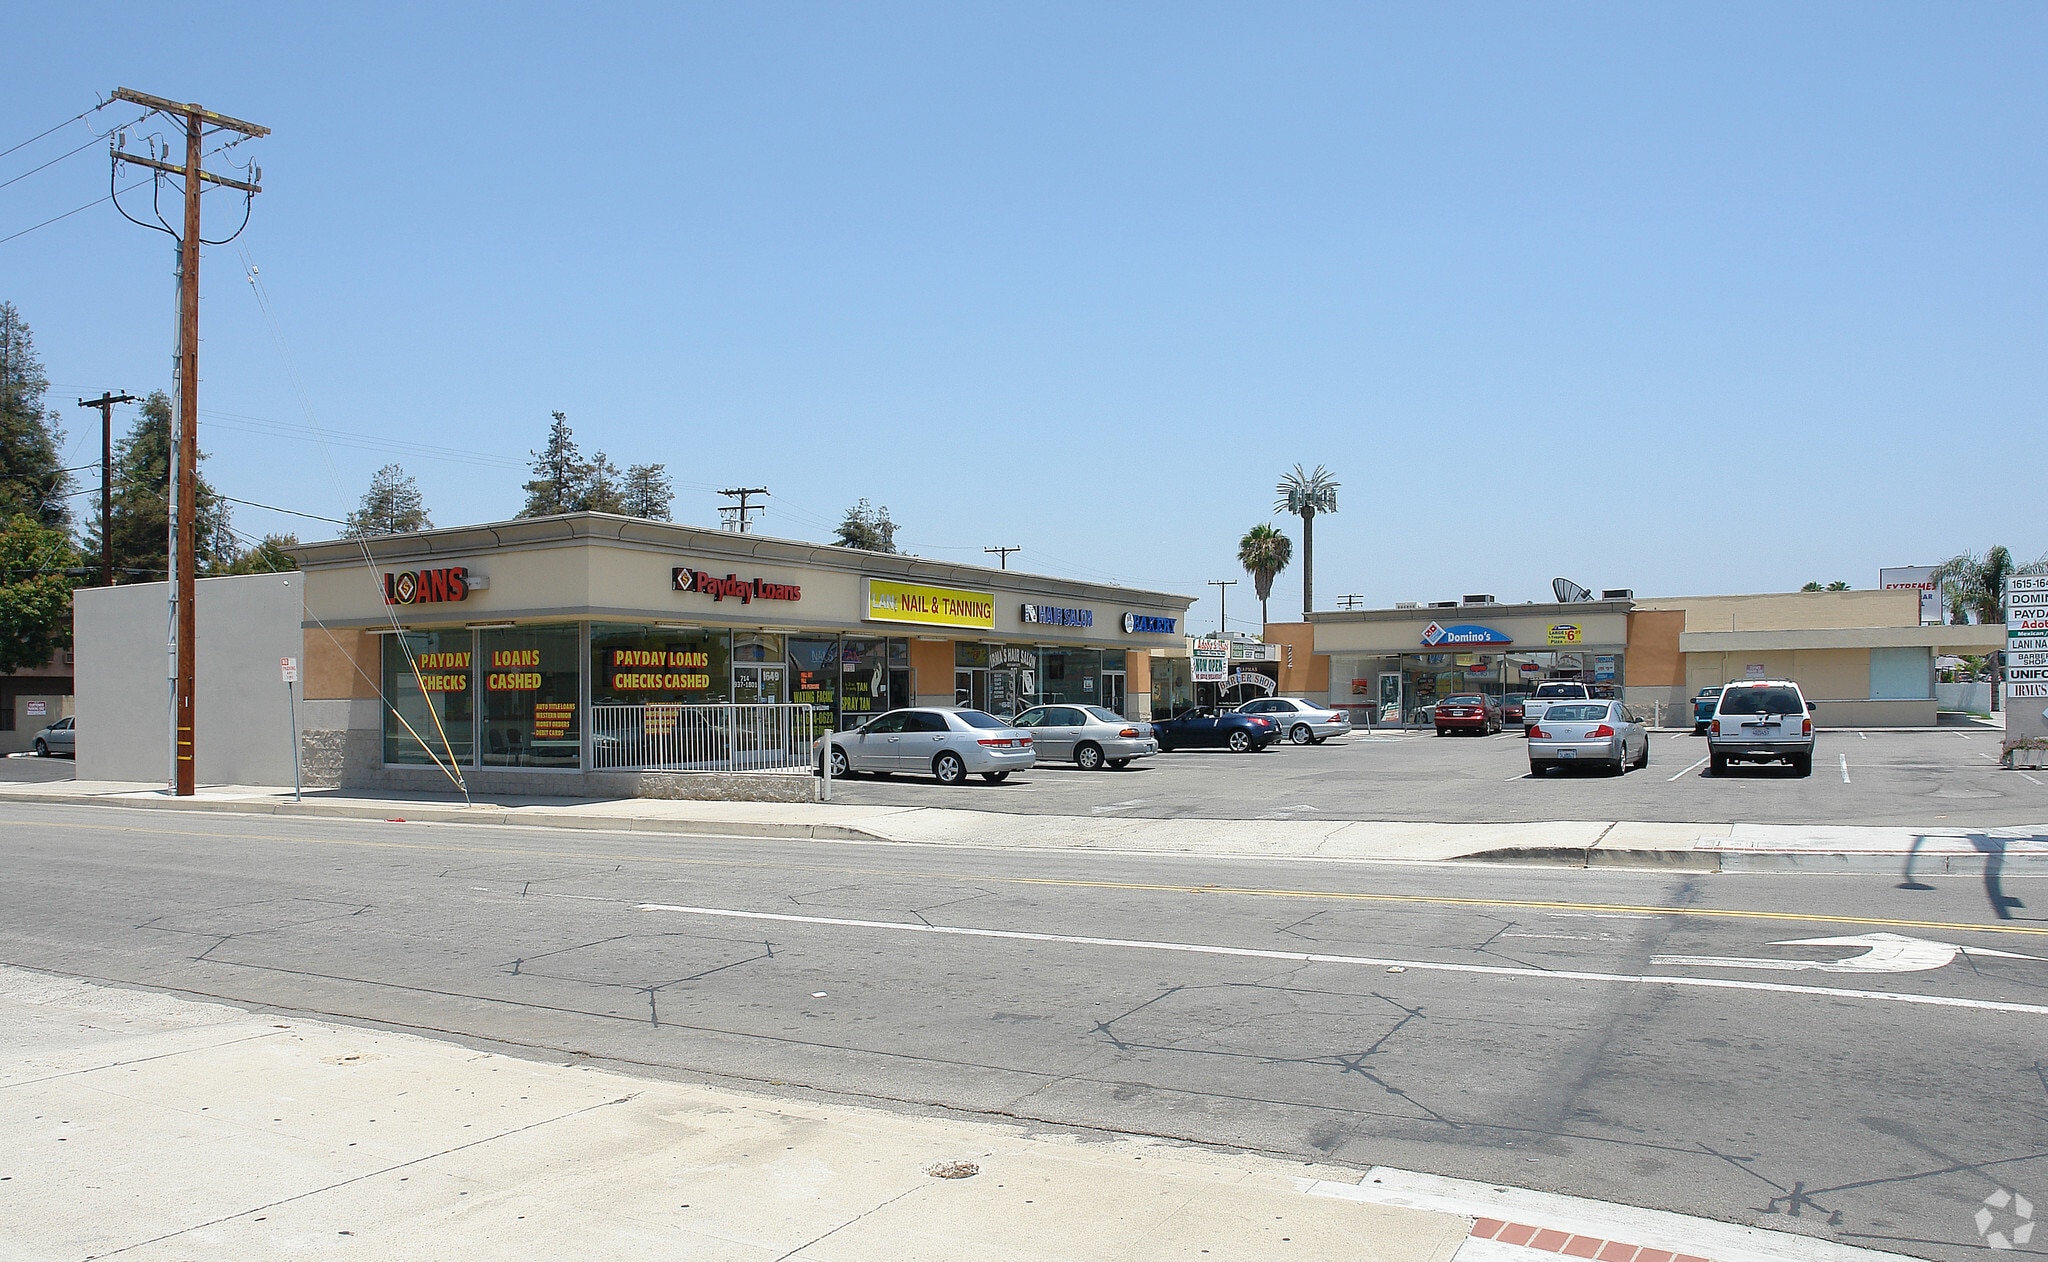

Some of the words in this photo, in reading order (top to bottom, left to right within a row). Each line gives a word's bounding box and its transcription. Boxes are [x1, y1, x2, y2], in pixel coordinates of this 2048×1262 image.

[384, 566, 468, 606] LOANS
[693, 571, 754, 605] Payday
[754, 577, 801, 601] Loans
[901, 593, 929, 613] NAIL
[931, 596, 939, 614] &
[942, 598, 991, 619] TANNING
[1038, 604, 1063, 626] HAIR
[1063, 607, 1094, 628] SALON
[1133, 614, 1177, 634] BAKERY
[1447, 631, 1491, 642] Domino's
[2012, 639, 2033, 649] LANI
[420, 651, 471, 671] PAYDAY
[492, 650, 541, 668] LOANS
[614, 650, 667, 668] PAYDAY
[667, 652, 709, 668] LOANS
[1007, 648, 1020, 662] HAIR
[1020, 649, 1037, 669] SALON
[1195, 658, 1208, 672] NOW
[1208, 658, 1223, 672] OPEN
[420, 674, 467, 692] CHECKS
[487, 673, 542, 691] CASHED
[613, 673, 663, 691] CHECKS
[663, 674, 710, 690] CASHED
[762, 671, 780, 681] 1649
[1220, 673, 1252, 690] BARER
[1254, 674, 1275, 689] SHOP
[856, 682, 868, 692] TAN
[2015, 684, 2047, 697] IRMA'S
[793, 691, 815, 703] WAXING
[816, 691, 834, 703] FACIAL
[841, 697, 858, 711] SPRAY
[859, 697, 871, 711] TAN
